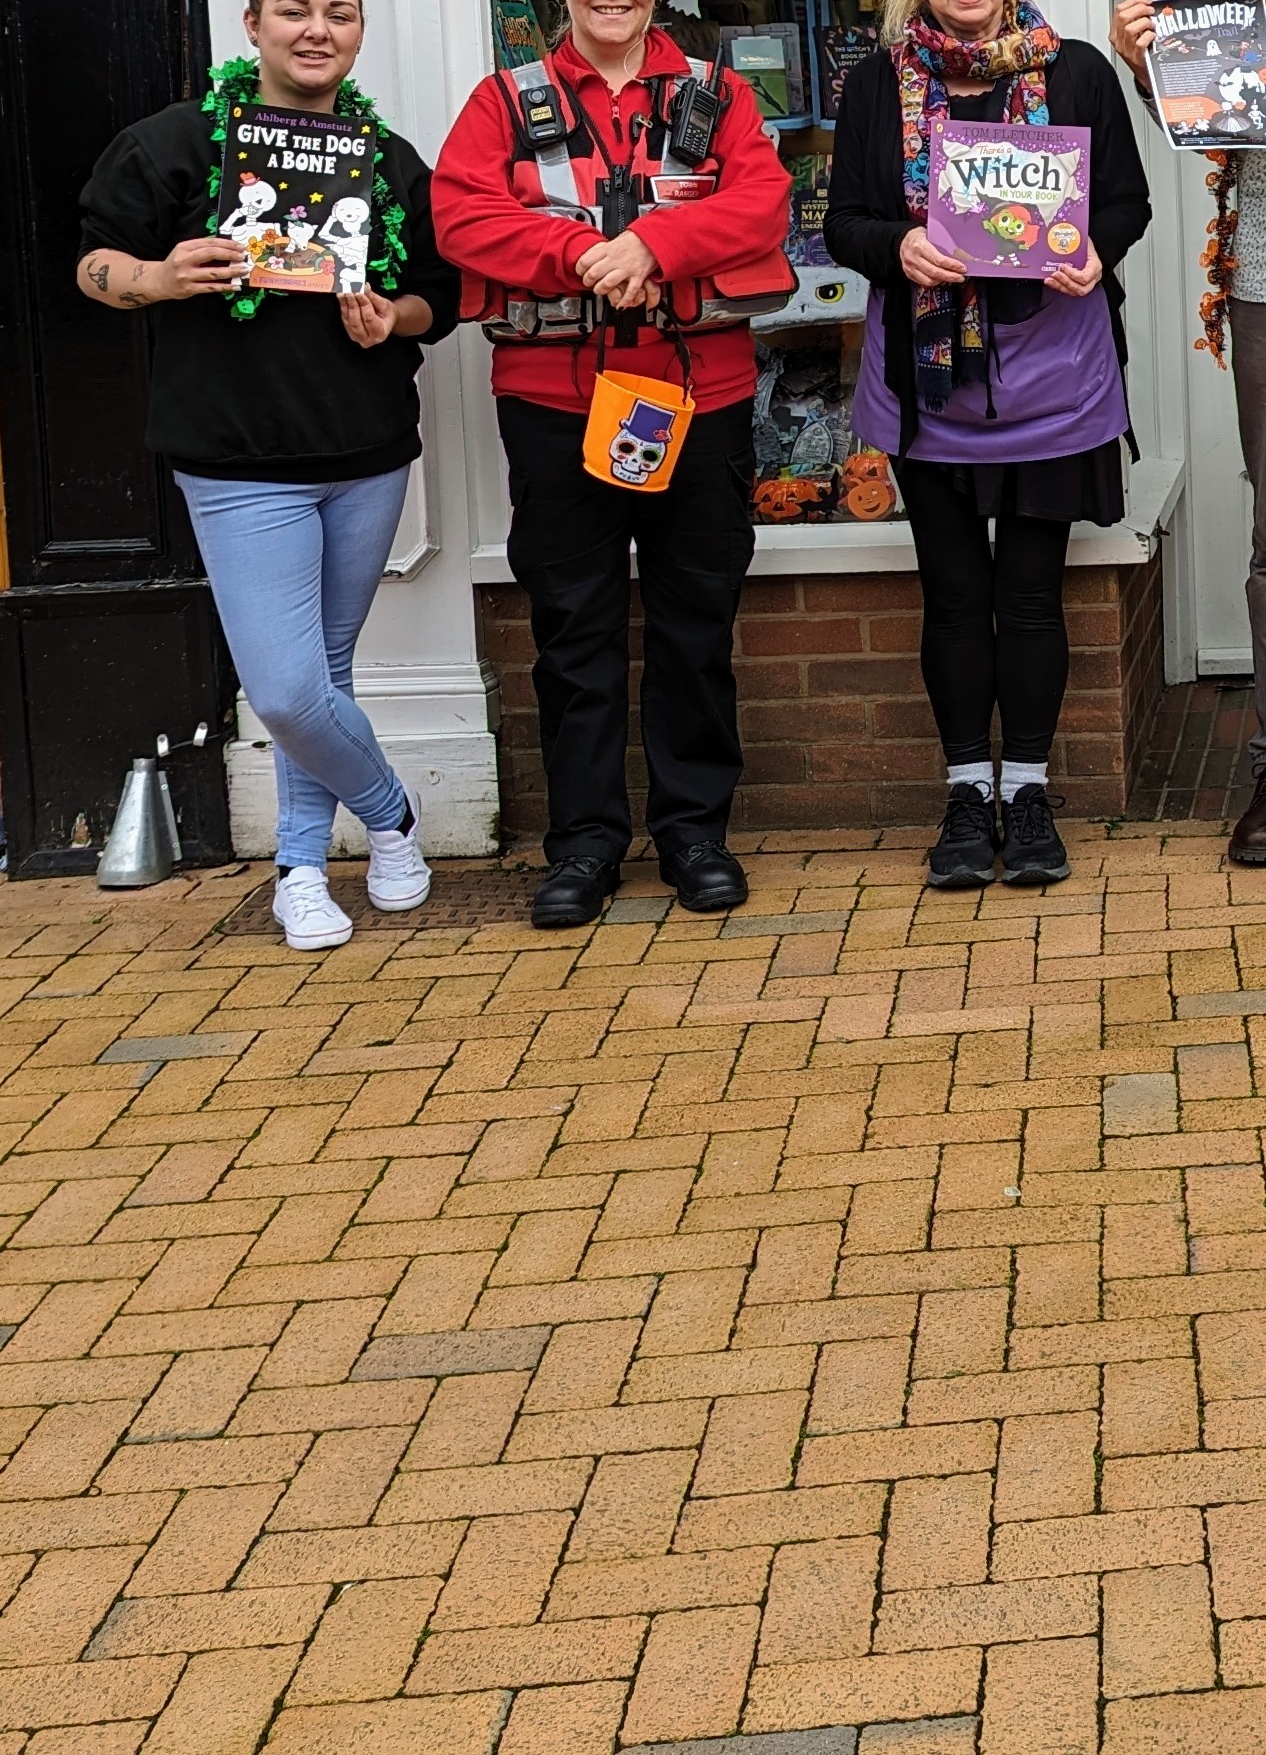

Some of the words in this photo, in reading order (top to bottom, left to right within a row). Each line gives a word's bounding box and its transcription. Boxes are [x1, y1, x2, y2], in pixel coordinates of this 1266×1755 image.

[1151, 1, 1258, 39] HALLOWEEN
[255, 112, 297, 127] Ahlberg
[299, 117, 309, 127] &
[309, 119, 353, 133] Amstutz
[962, 126, 990, 140] TOM
[993, 128, 1065, 142] FLETCHER
[237, 124, 289, 148] GIVE
[292, 135, 322, 152] THE
[325, 134, 367, 157] DOG
[267, 153, 278, 169] A
[281, 151, 338, 175] BONE
[950, 153, 1062, 192] Witch
[999, 189, 1008, 198] IN
[1009, 190, 1032, 200] YOUR
[1035, 190, 1058, 201] BOOK
